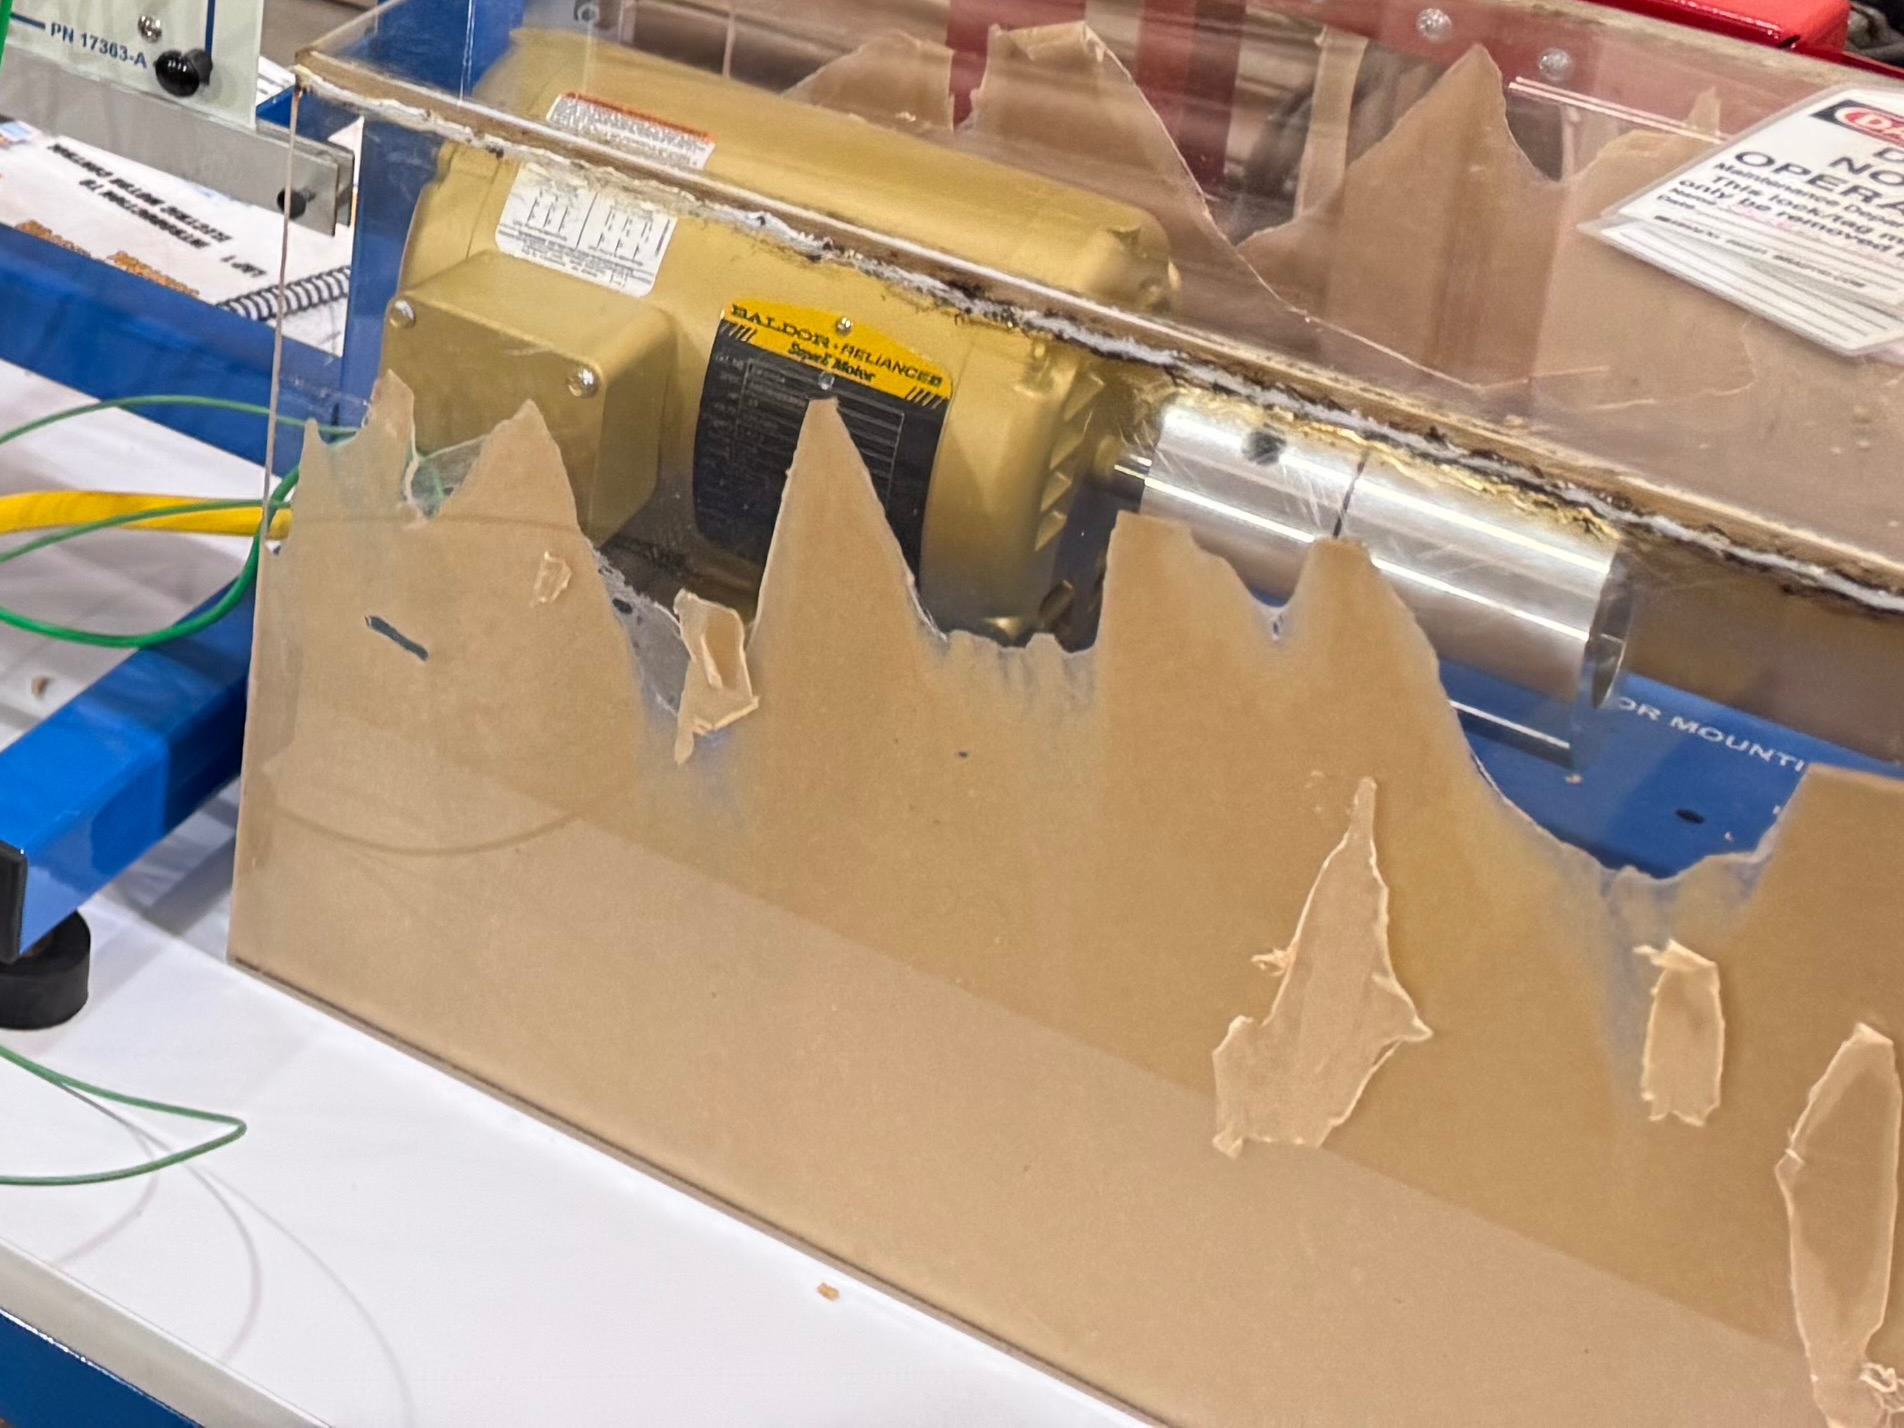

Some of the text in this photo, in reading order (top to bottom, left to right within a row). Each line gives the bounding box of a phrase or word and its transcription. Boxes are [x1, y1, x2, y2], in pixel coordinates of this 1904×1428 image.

[51, 22, 74, 43] PN
[1712, 175, 1763, 197] This
[732, 304, 830, 350] BALDOR
[1670, 715, 1805, 772] MOUNTI
